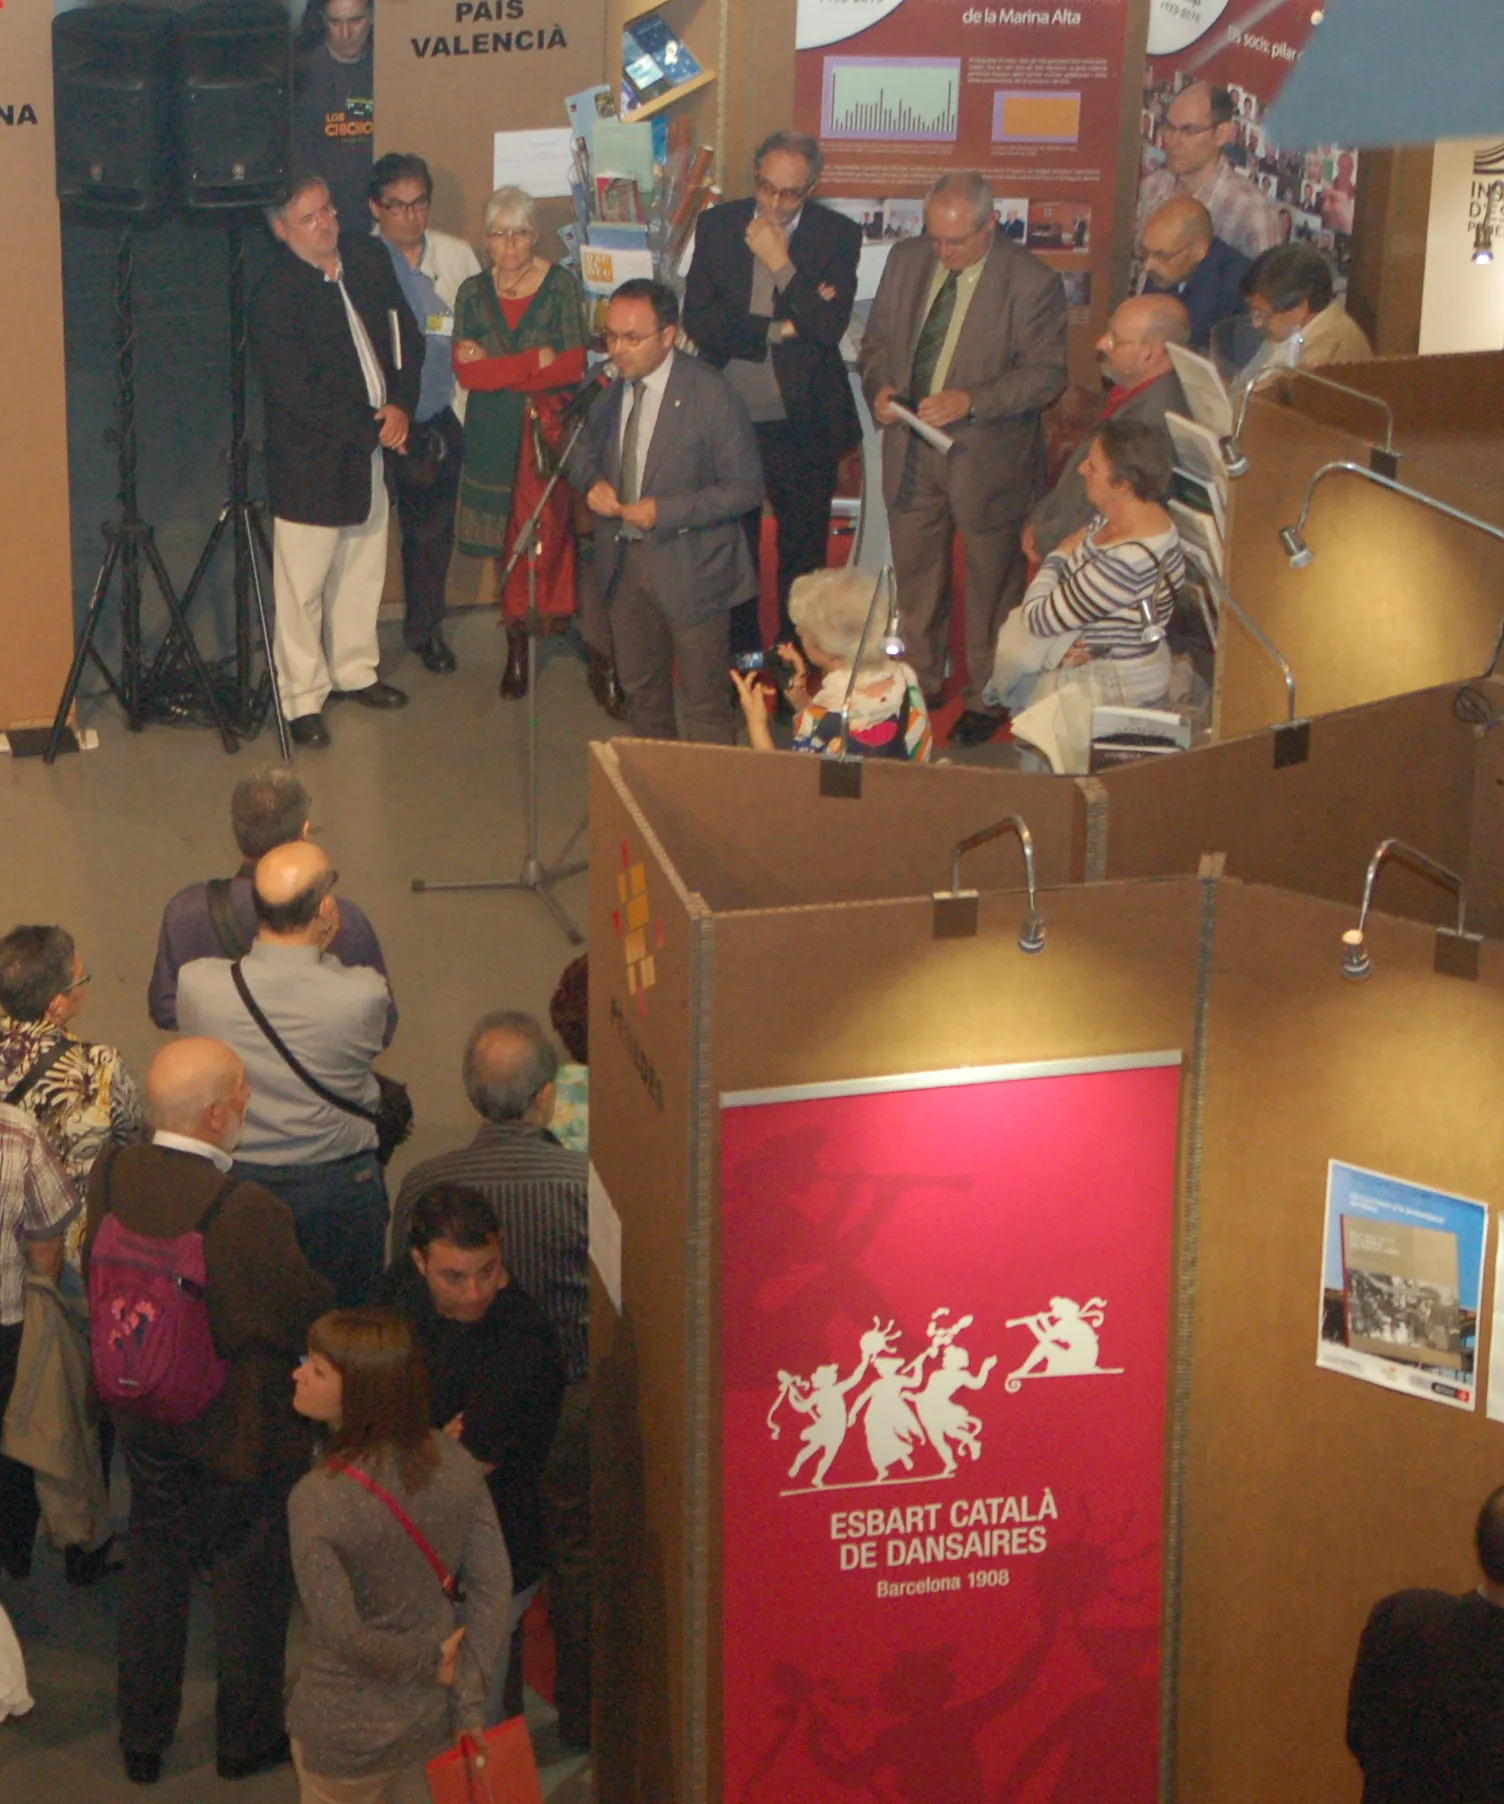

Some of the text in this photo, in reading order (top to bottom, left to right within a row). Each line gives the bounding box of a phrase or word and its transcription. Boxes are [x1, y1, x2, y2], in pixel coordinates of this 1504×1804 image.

[962, 8, 1081, 25] de la Marina Alta
[411, 24, 567, 58] VALENCIÀ
[1271, 42, 1297, 60] pilar
[831, 1487, 1058, 1540] ESBART CATALÀ
[840, 1526, 1048, 1571] DE DANSAIRES
[877, 1569, 1010, 1598] Barcelona 1908
